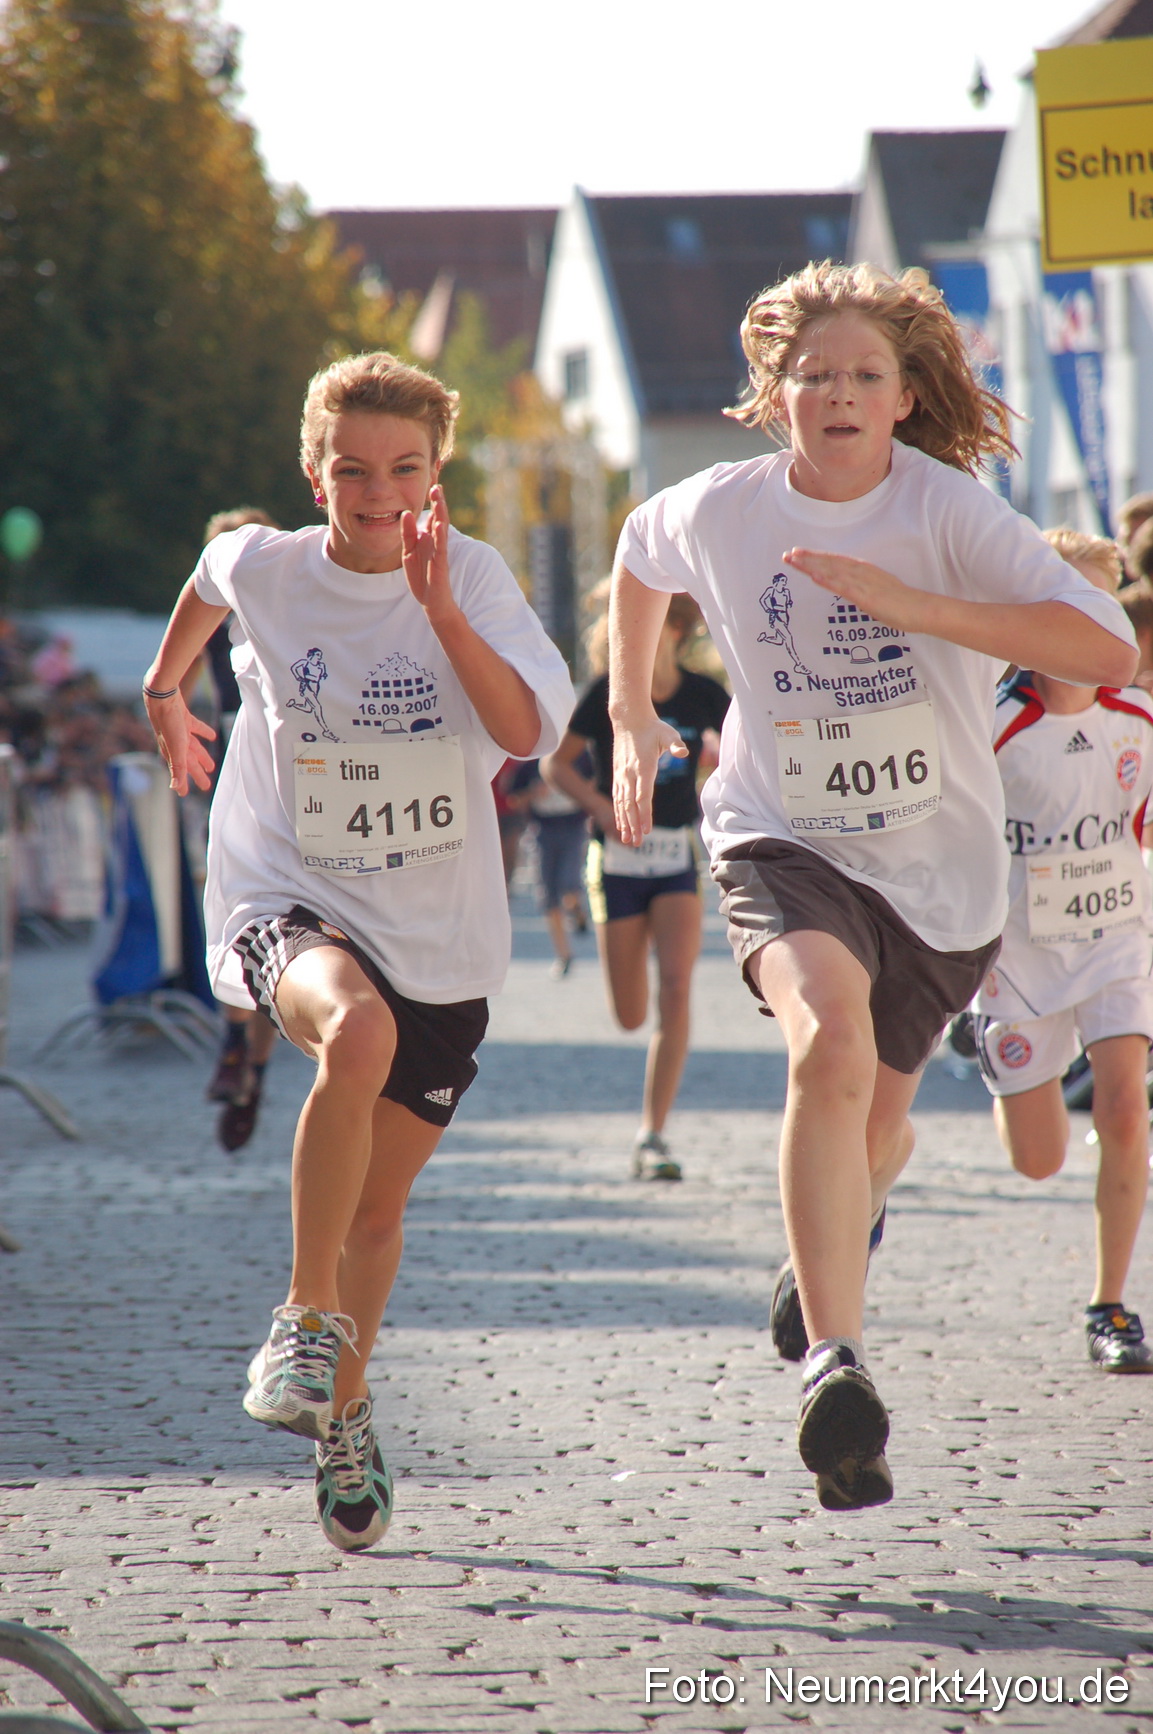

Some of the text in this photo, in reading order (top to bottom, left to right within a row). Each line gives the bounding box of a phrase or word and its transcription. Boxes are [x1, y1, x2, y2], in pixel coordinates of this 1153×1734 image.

[1055, 145, 1153, 181] Schn
[773, 666, 914, 693] 8. Neumarkter
[834, 678, 917, 707] Stadtlauf
[358, 695, 438, 716] 16.09.2007
[812, 718, 851, 741] Tim
[340, 759, 380, 781] tina
[784, 757, 802, 775] Ju
[826, 749, 928, 798] 4016
[304, 795, 323, 814] Ju
[885, 794, 938, 821] PFLEIDERER
[346, 794, 454, 839] 4116
[404, 838, 463, 860] PFLEIDERER
[1061, 859, 1113, 880] Florian
[1064, 881, 1134, 918] 4085
[424, 1092, 453, 1107] adidas
